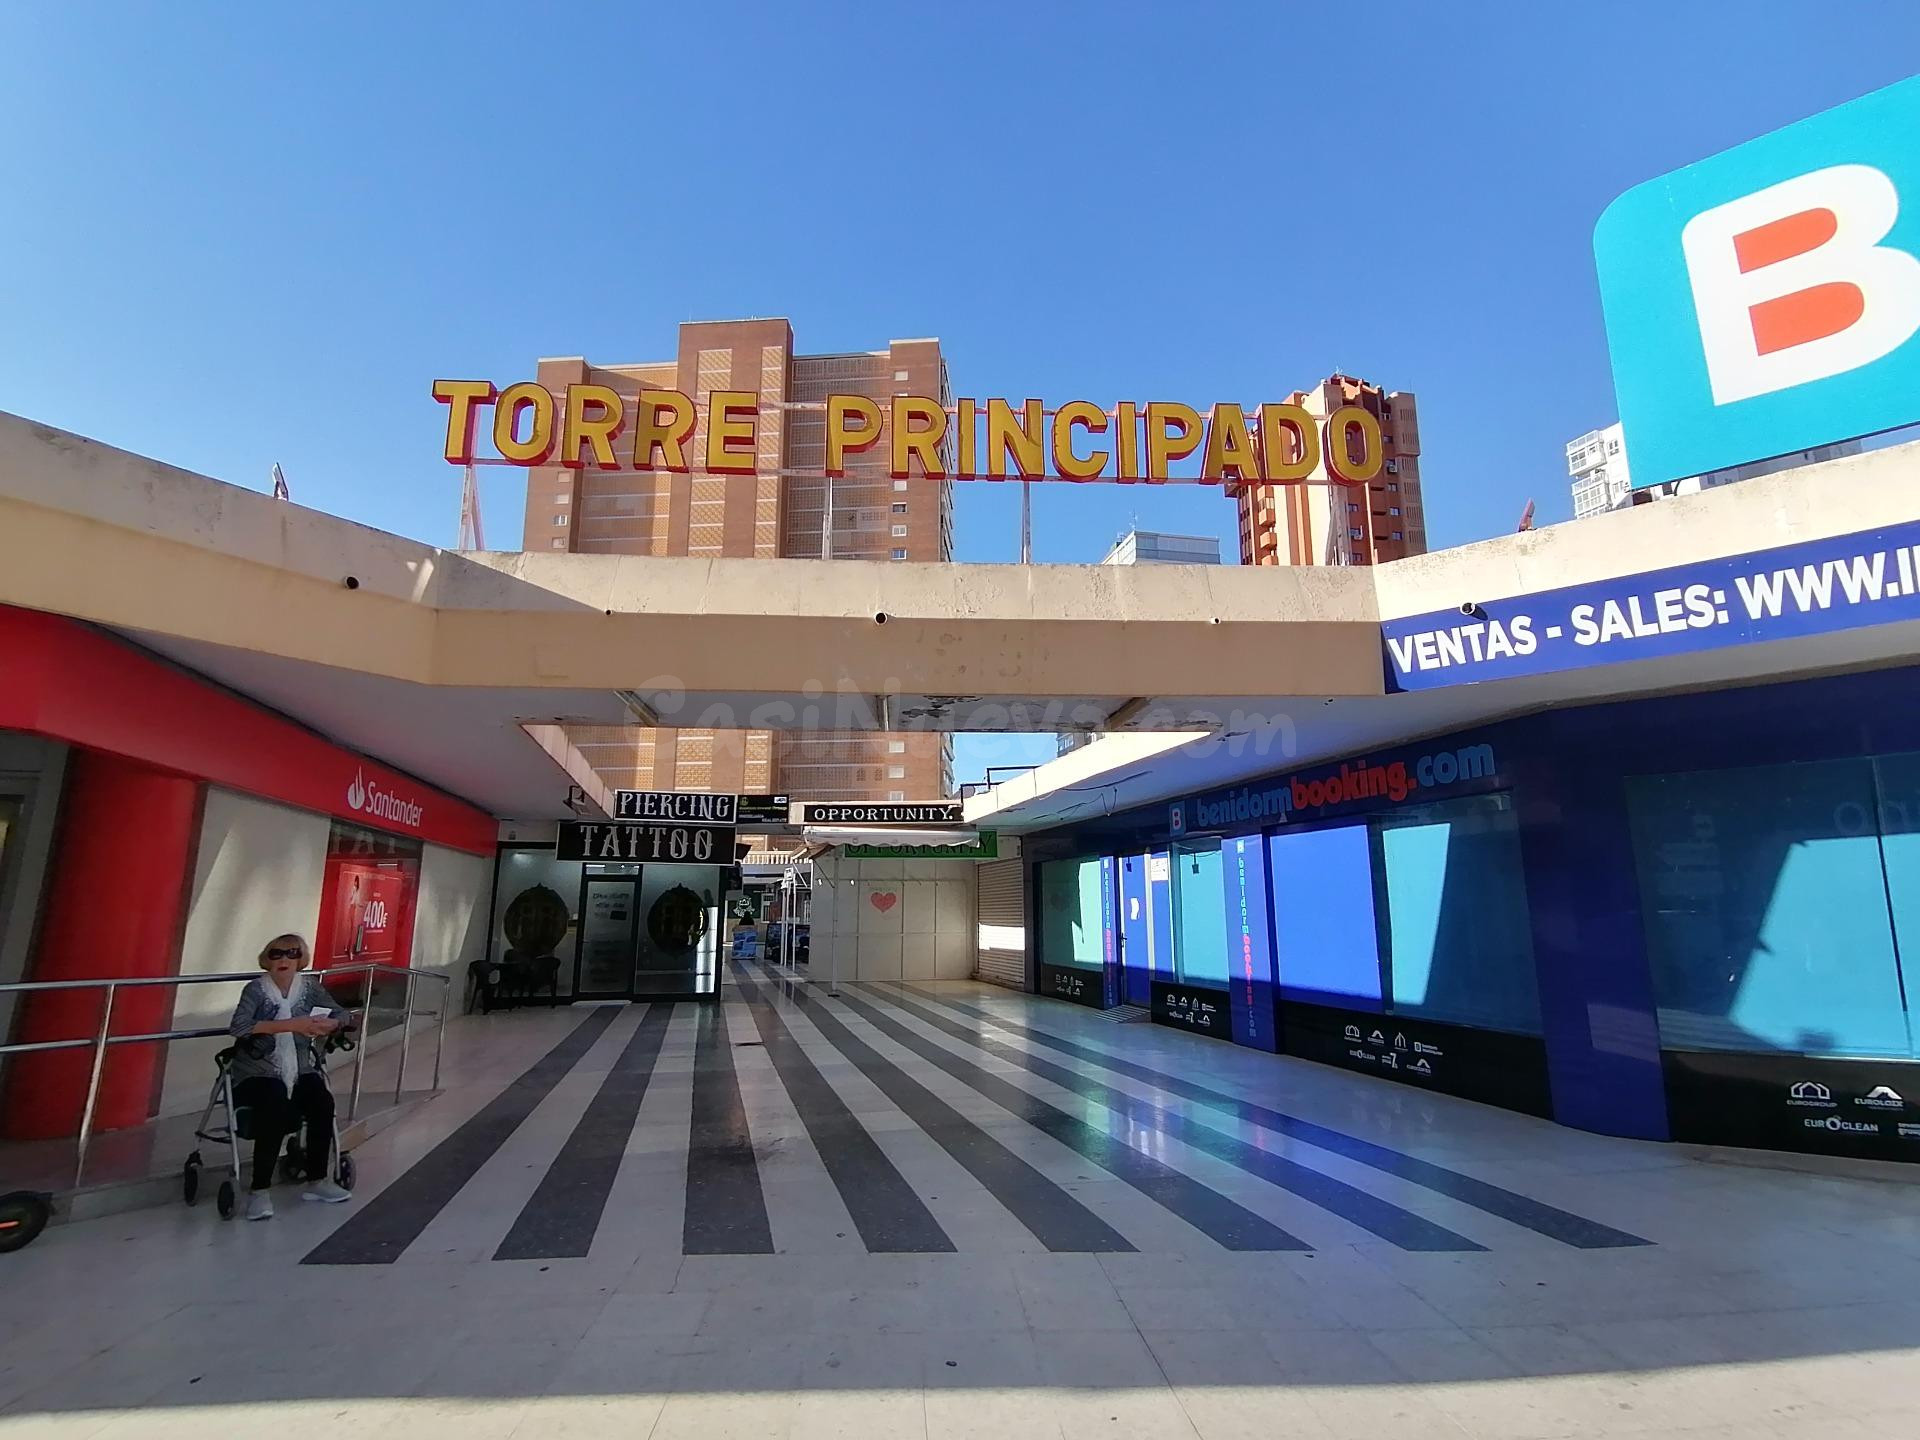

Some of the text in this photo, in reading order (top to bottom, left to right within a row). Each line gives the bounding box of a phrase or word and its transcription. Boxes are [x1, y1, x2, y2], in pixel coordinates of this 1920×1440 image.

[1682, 164, 1920, 406] B
[432, 379, 1384, 486] TORRE PRINCIPADO
[1388, 615, 1538, 673] VENTAS
[1571, 584, 1729, 646] SALES:
[365, 781, 423, 828] Santander
[619, 792, 730, 820] PIERCING
[1196, 743, 1496, 828] benidormbooking.com
[580, 824, 713, 860] TATTOO
